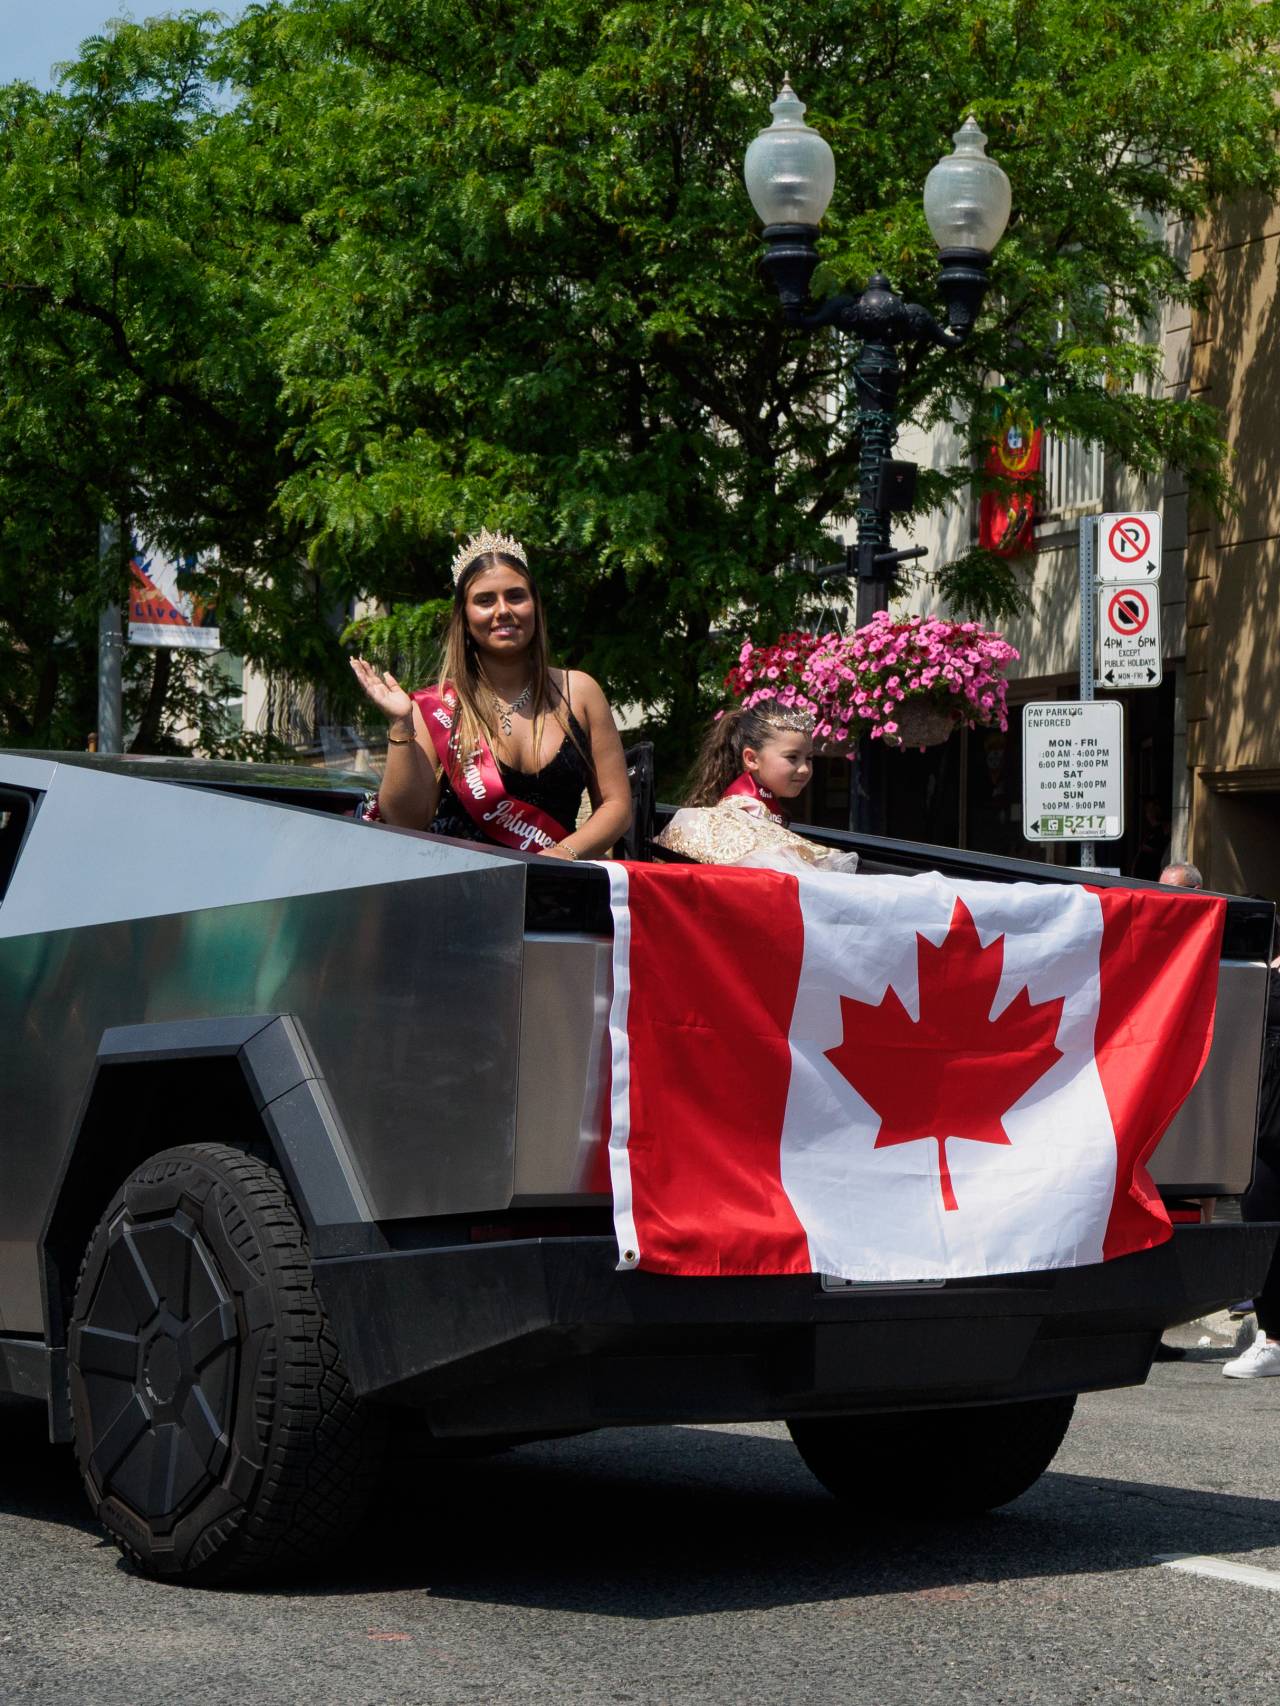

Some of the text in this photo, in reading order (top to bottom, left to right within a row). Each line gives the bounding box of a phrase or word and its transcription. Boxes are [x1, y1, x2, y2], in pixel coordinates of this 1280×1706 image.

[1104, 636, 1122, 648] 4PM
[1138, 635, 1156, 648] 6PM
[1118, 649, 1141, 657] EXCEPT
[1104, 658, 1156, 668] PUBLIC HOLIDAYS
[1028, 708, 1043, 717] PAY
[1028, 718, 1071, 727] ENFORCED
[1048, 739, 1072, 747] MON
[1081, 738, 1098, 747] FRI
[1057, 749, 1070, 758] AM
[1076, 749, 1095, 758] 4:00
[1096, 749, 1109, 757] PM
[1038, 760, 1056, 769] 6:00
[1057, 760, 1070, 768] PM
[1076, 760, 1094, 768] 9:00
[1095, 759, 1108, 767] PM
[1063, 770, 1083, 778] SAT
[1040, 781, 1057, 789] 8:00
[1058, 780, 1071, 789] AM
[1076, 780, 1093, 789] 9:00
[1095, 780, 1107, 788] PM
[1063, 791, 1084, 799] SUN
[1057, 801, 1070, 809] PM
[1075, 801, 1092, 809] 9:00
[1093, 801, 1106, 809] PM
[1064, 815, 1106, 828] 5217
